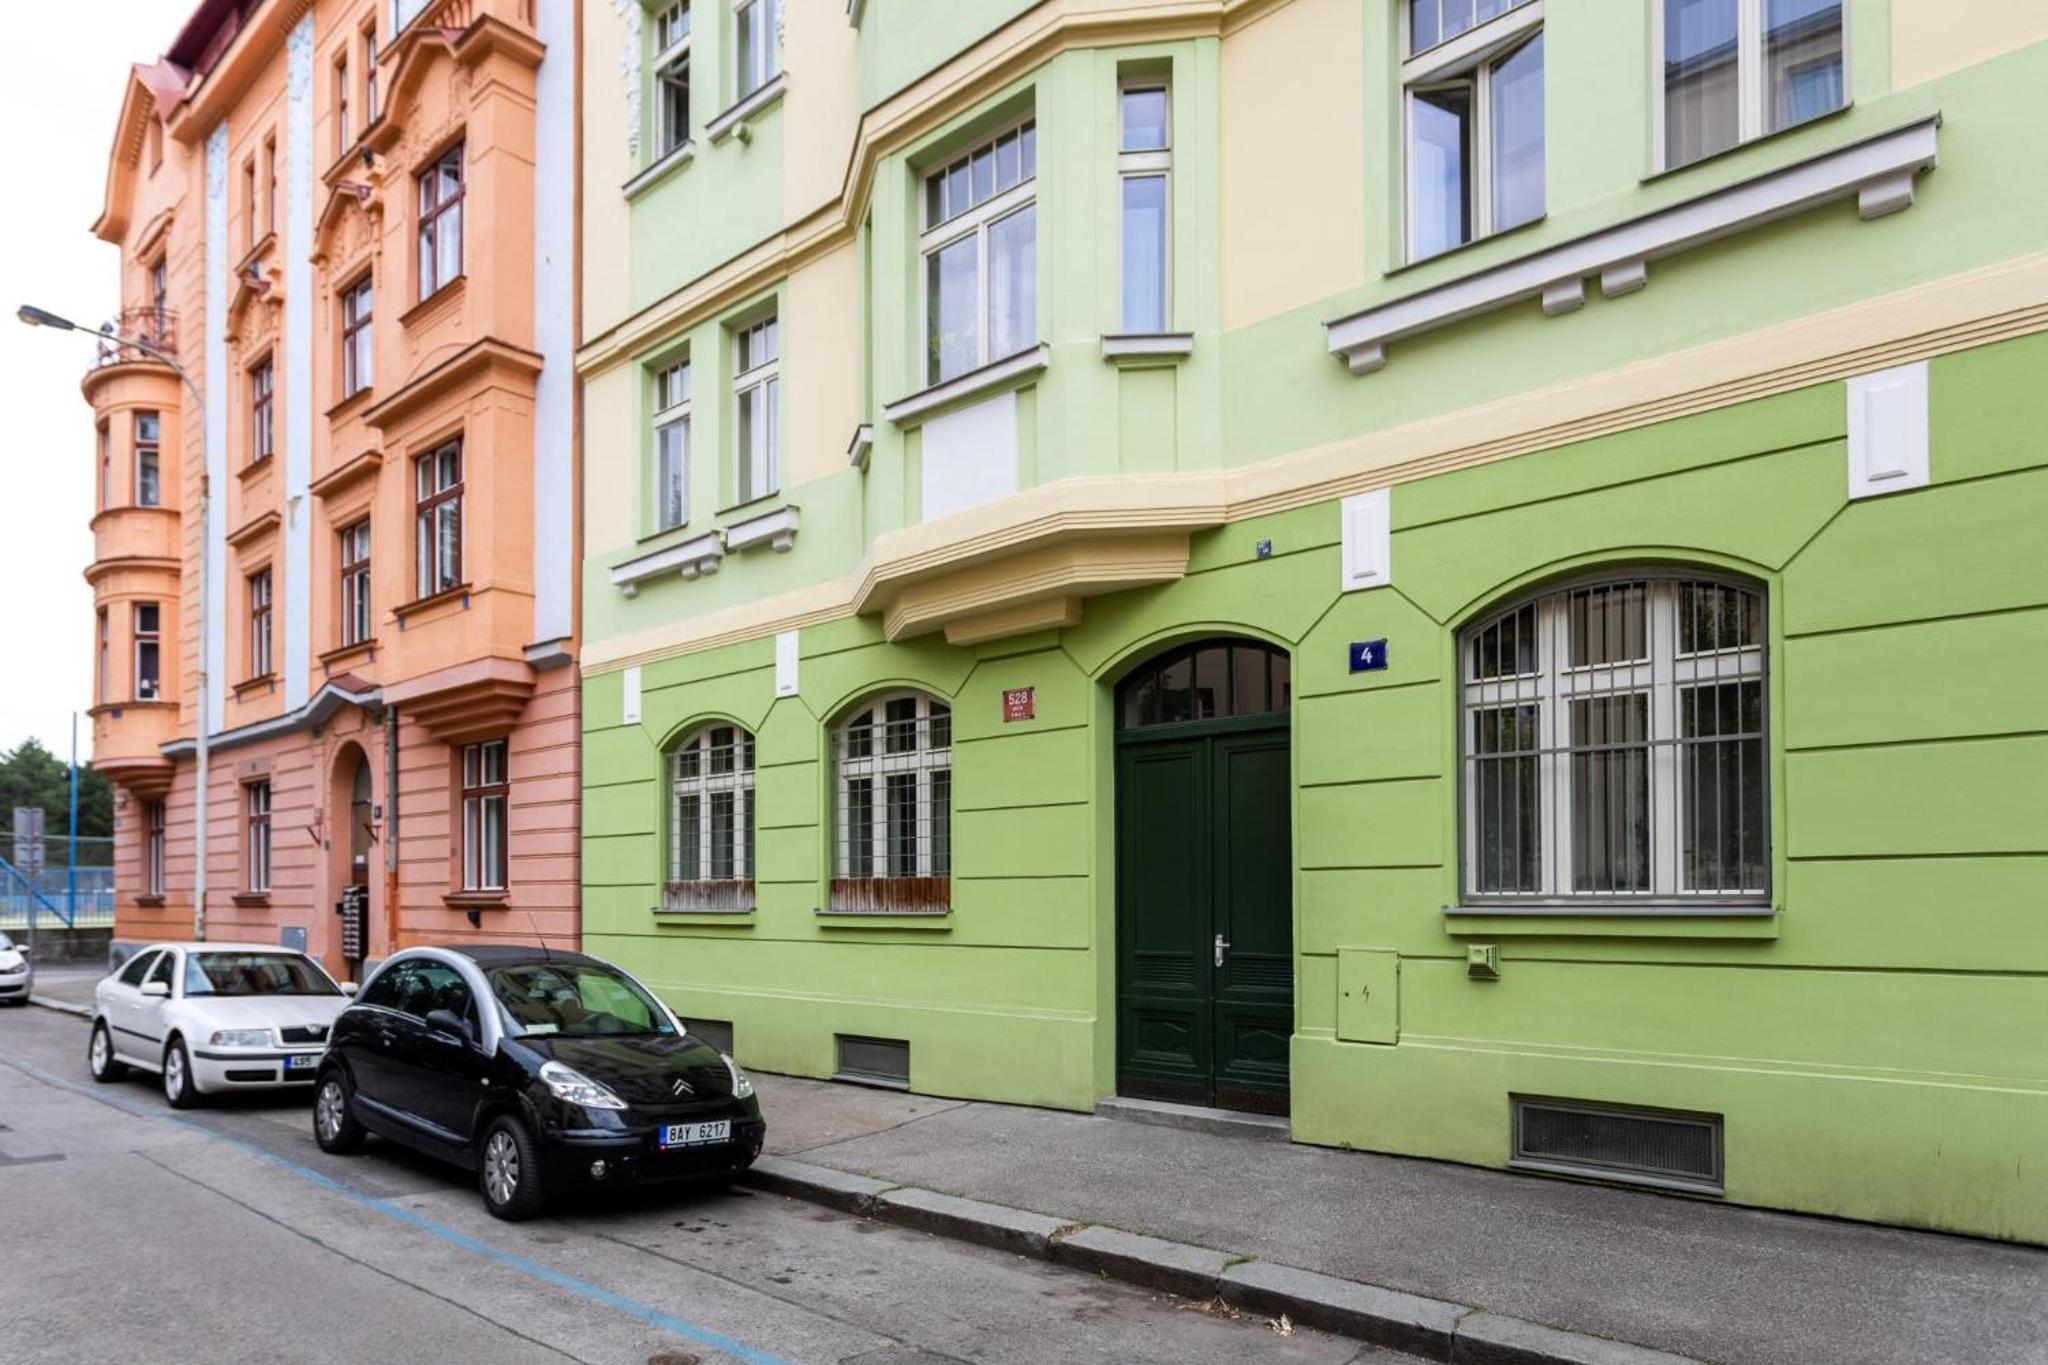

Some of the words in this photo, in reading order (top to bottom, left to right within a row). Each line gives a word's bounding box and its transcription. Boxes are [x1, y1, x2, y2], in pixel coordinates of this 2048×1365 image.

[1360, 647, 1373, 664] 4
[1008, 691, 1028, 705] 528
[669, 1126, 691, 1142] 8AY
[699, 1122, 726, 1138] 6217
